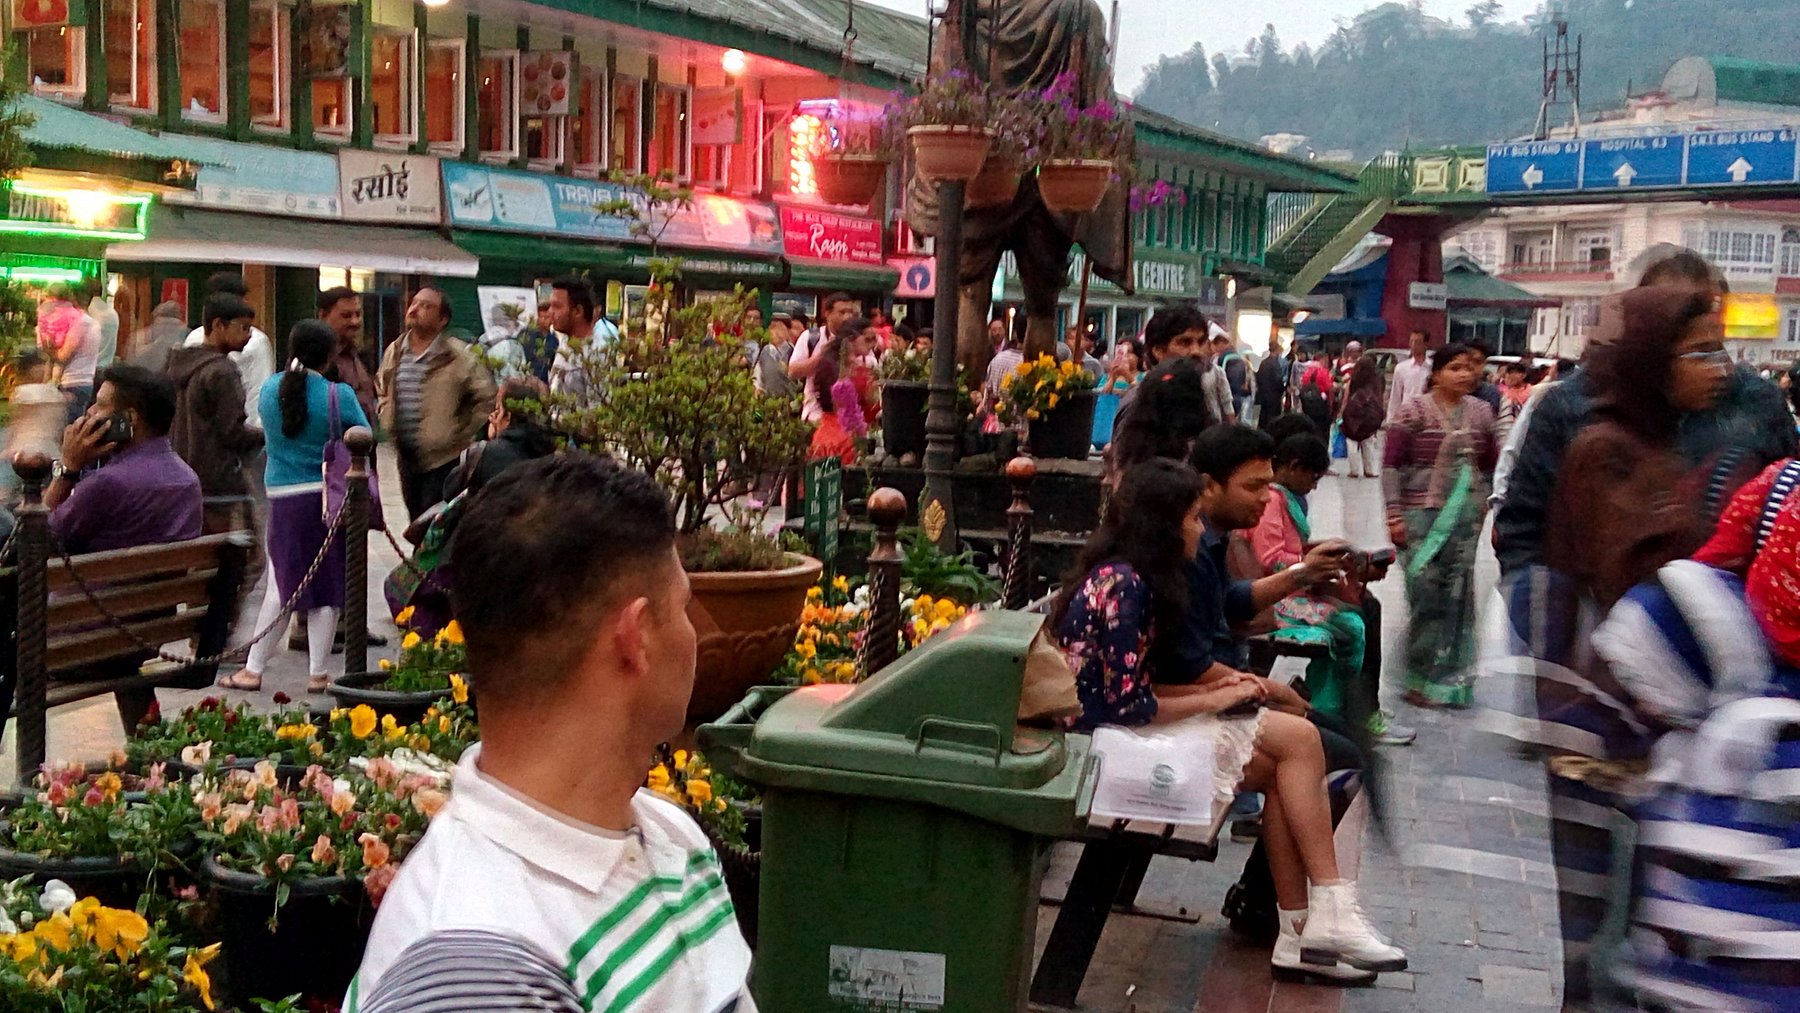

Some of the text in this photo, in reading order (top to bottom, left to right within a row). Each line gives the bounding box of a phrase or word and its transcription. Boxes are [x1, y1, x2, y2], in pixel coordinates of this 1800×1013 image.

[1601, 138, 1647, 152] HOSPITAL
[352, 160, 411, 203] रसोई
[809, 223, 849, 259] Rasoi
[1142, 260, 1185, 293] CENTRE
